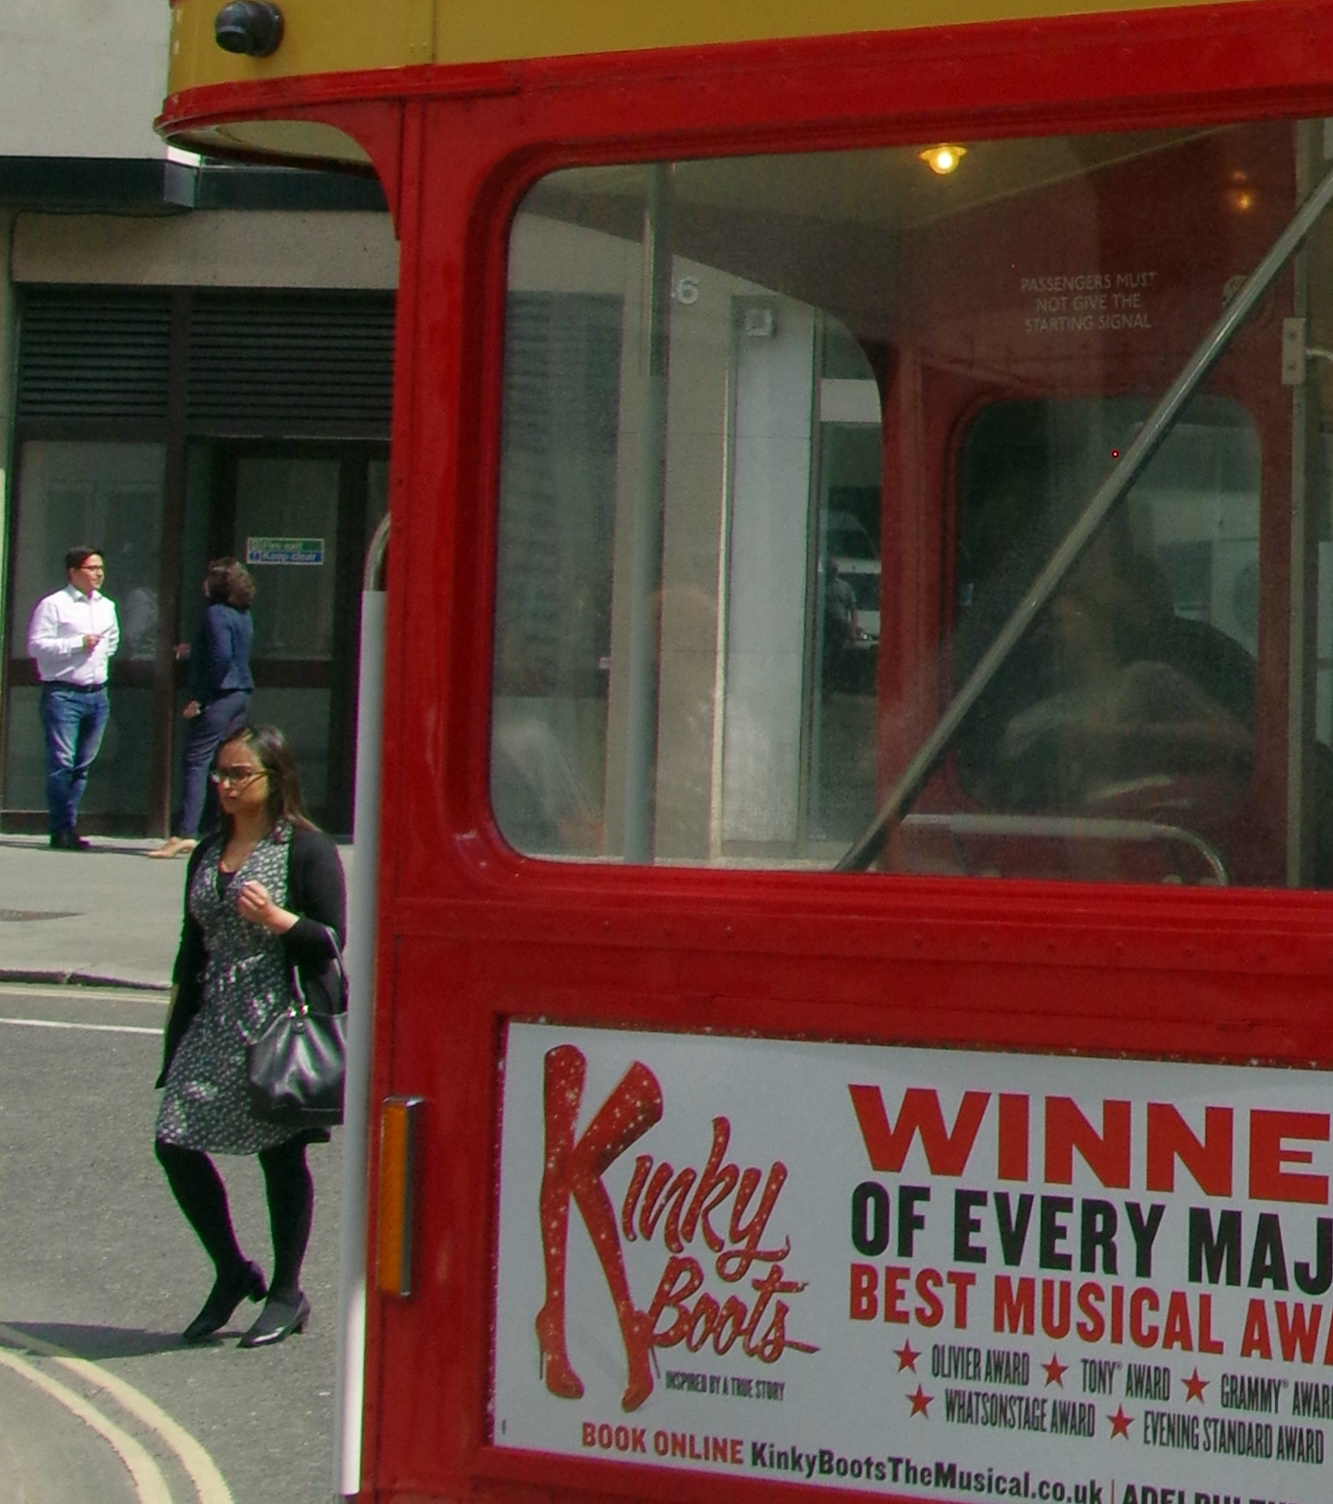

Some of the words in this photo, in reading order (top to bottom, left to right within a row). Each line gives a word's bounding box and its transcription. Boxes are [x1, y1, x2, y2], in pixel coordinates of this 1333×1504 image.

[1021, 274, 1112, 293] PASSENGERS
[1116, 272, 1156, 289] MUST
[1036, 295, 1067, 312] NOT
[1073, 294, 1107, 311] GIVE
[1113, 293, 1141, 309] THE
[1025, 314, 1094, 333] STARTING
[1099, 313, 1152, 330] SIGNAL
[851, 1181, 931, 1258] OF
[953, 1188, 1166, 1278] EVERY
[648, 1264, 822, 1364] Boots
[849, 1263, 977, 1330] BEST
[993, 1274, 1224, 1355] MUSICAL
[665, 1370, 707, 1393] INSPIRED
[710, 1376, 722, 1395] BY
[723, 1378, 730, 1396] A
[731, 1378, 753, 1399] TRUE
[755, 1380, 785, 1401] STORY
[931, 1344, 982, 1381] OLIVIER
[985, 1349, 1031, 1386] AWARD
[1125, 1363, 1171, 1402] AWARD
[945, 1388, 1048, 1433] WHATSONSTAGE
[1049, 1399, 1095, 1438] AWARD
[582, 1422, 647, 1453] BOOK
[654, 1430, 744, 1464] ONLINE
[1143, 1410, 1200, 1451] EVENING
[1203, 1417, 1273, 1460] STANDARD
[1276, 1426, 1324, 1465] AWARD
